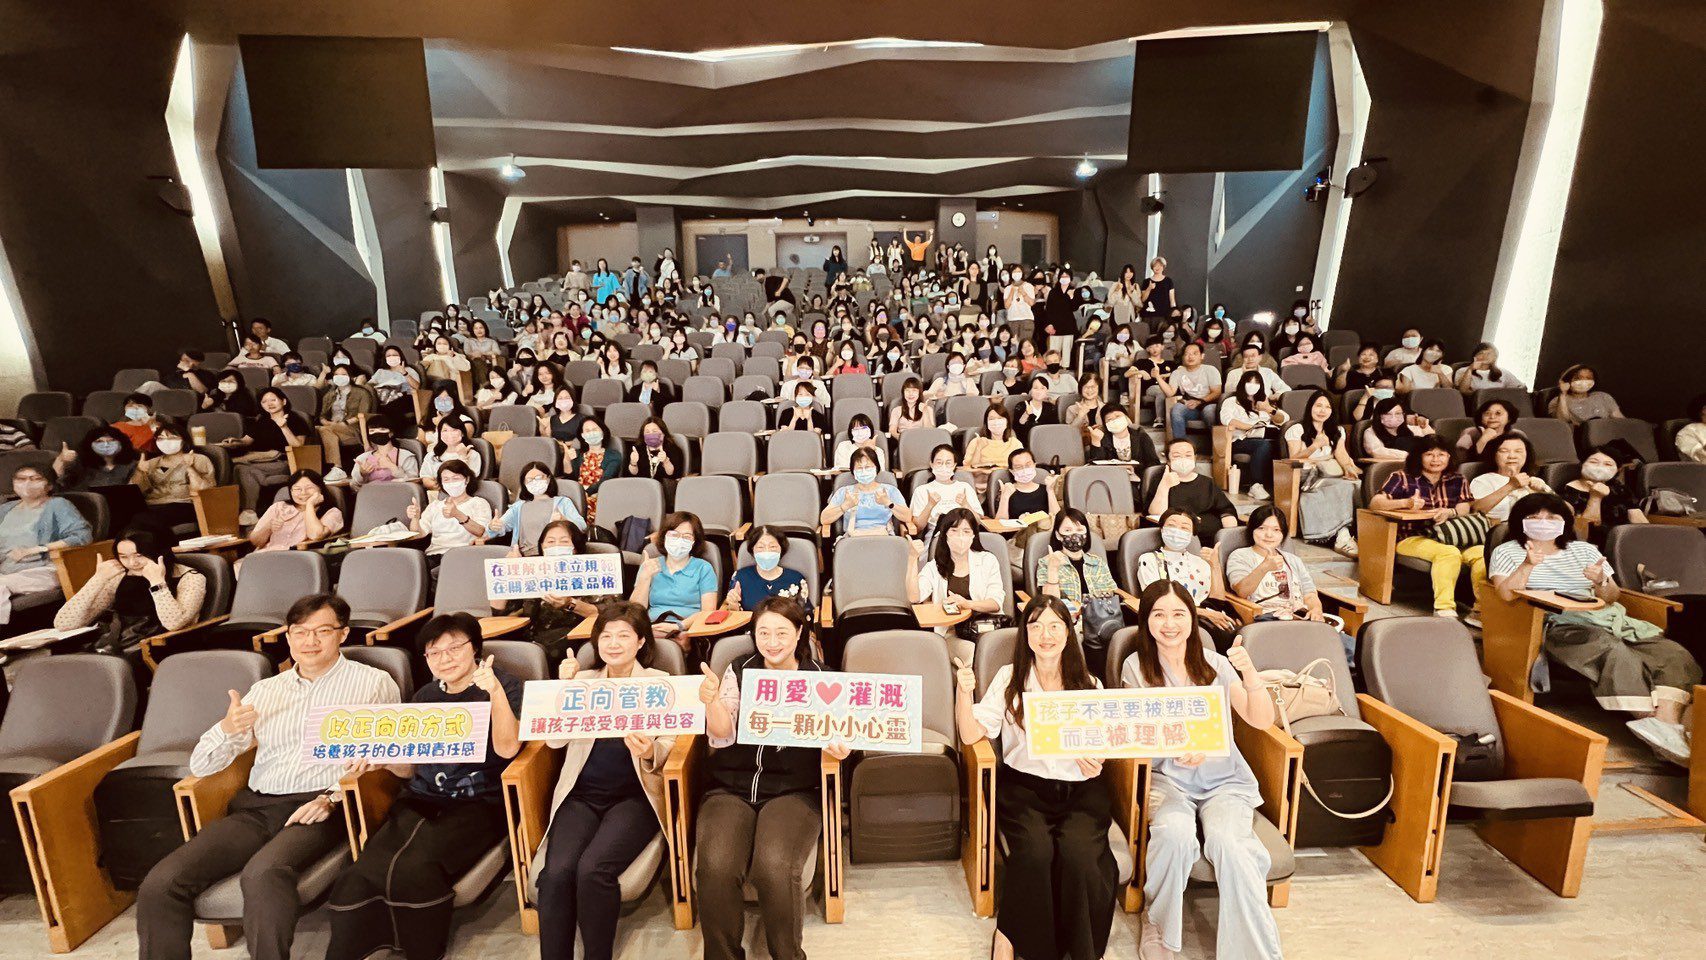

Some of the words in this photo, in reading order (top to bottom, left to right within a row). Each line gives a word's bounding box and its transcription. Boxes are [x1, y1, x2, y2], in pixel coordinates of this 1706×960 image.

[491, 560, 614, 577] 在理解中建立規範
[493, 576, 614, 594] 在關愛中培養品格
[562, 685, 669, 711] 正向管教
[755, 679, 808, 703] 用愛
[849, 681, 903, 708] 灌溉
[1039, 698, 1208, 721] 孩子不是要被塑造
[328, 713, 466, 738] 以正向的方式
[531, 712, 694, 734] 讓孩子感受尊重與包容
[749, 711, 907, 741] 每一顆小小心靈
[1061, 723, 1187, 748] 而是被理解
[313, 741, 476, 759] 培養孩子的自律與責任感
